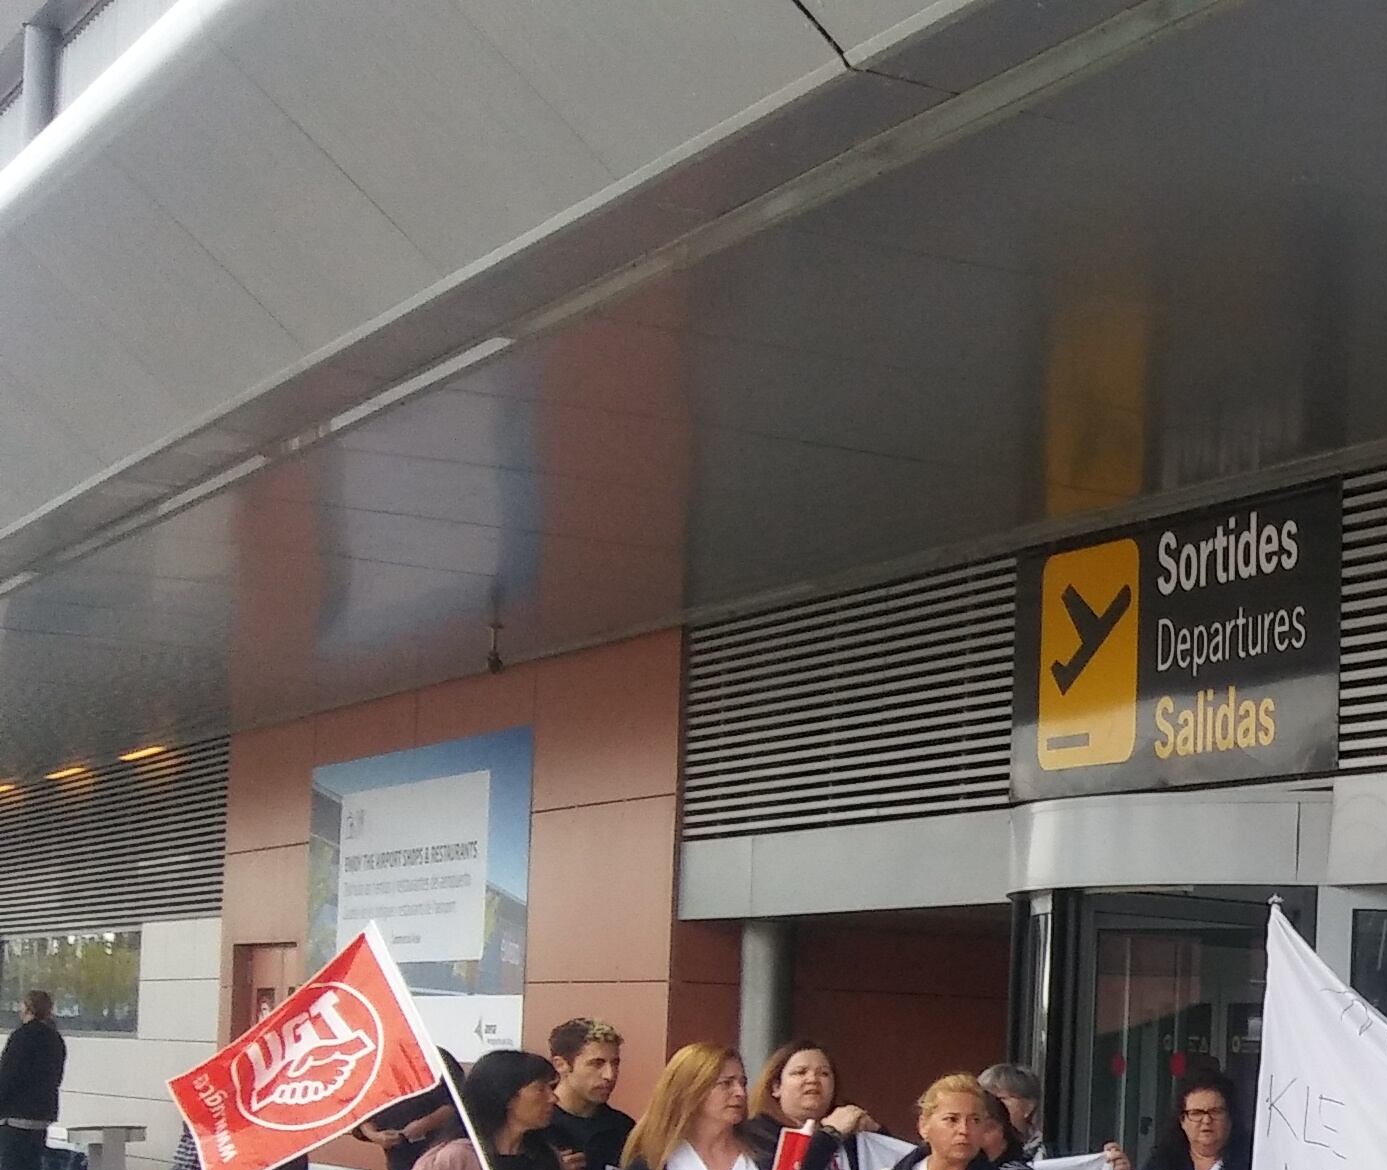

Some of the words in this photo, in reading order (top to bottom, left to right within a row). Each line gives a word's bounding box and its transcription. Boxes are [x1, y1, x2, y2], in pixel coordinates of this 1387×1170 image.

[1156, 511, 1299, 595] Sortides
[1156, 605, 1307, 676] Departures
[1155, 686, 1276, 760] Salidas
[244, 989, 353, 1092] UGT
[1265, 1073, 1348, 1160] KLE
